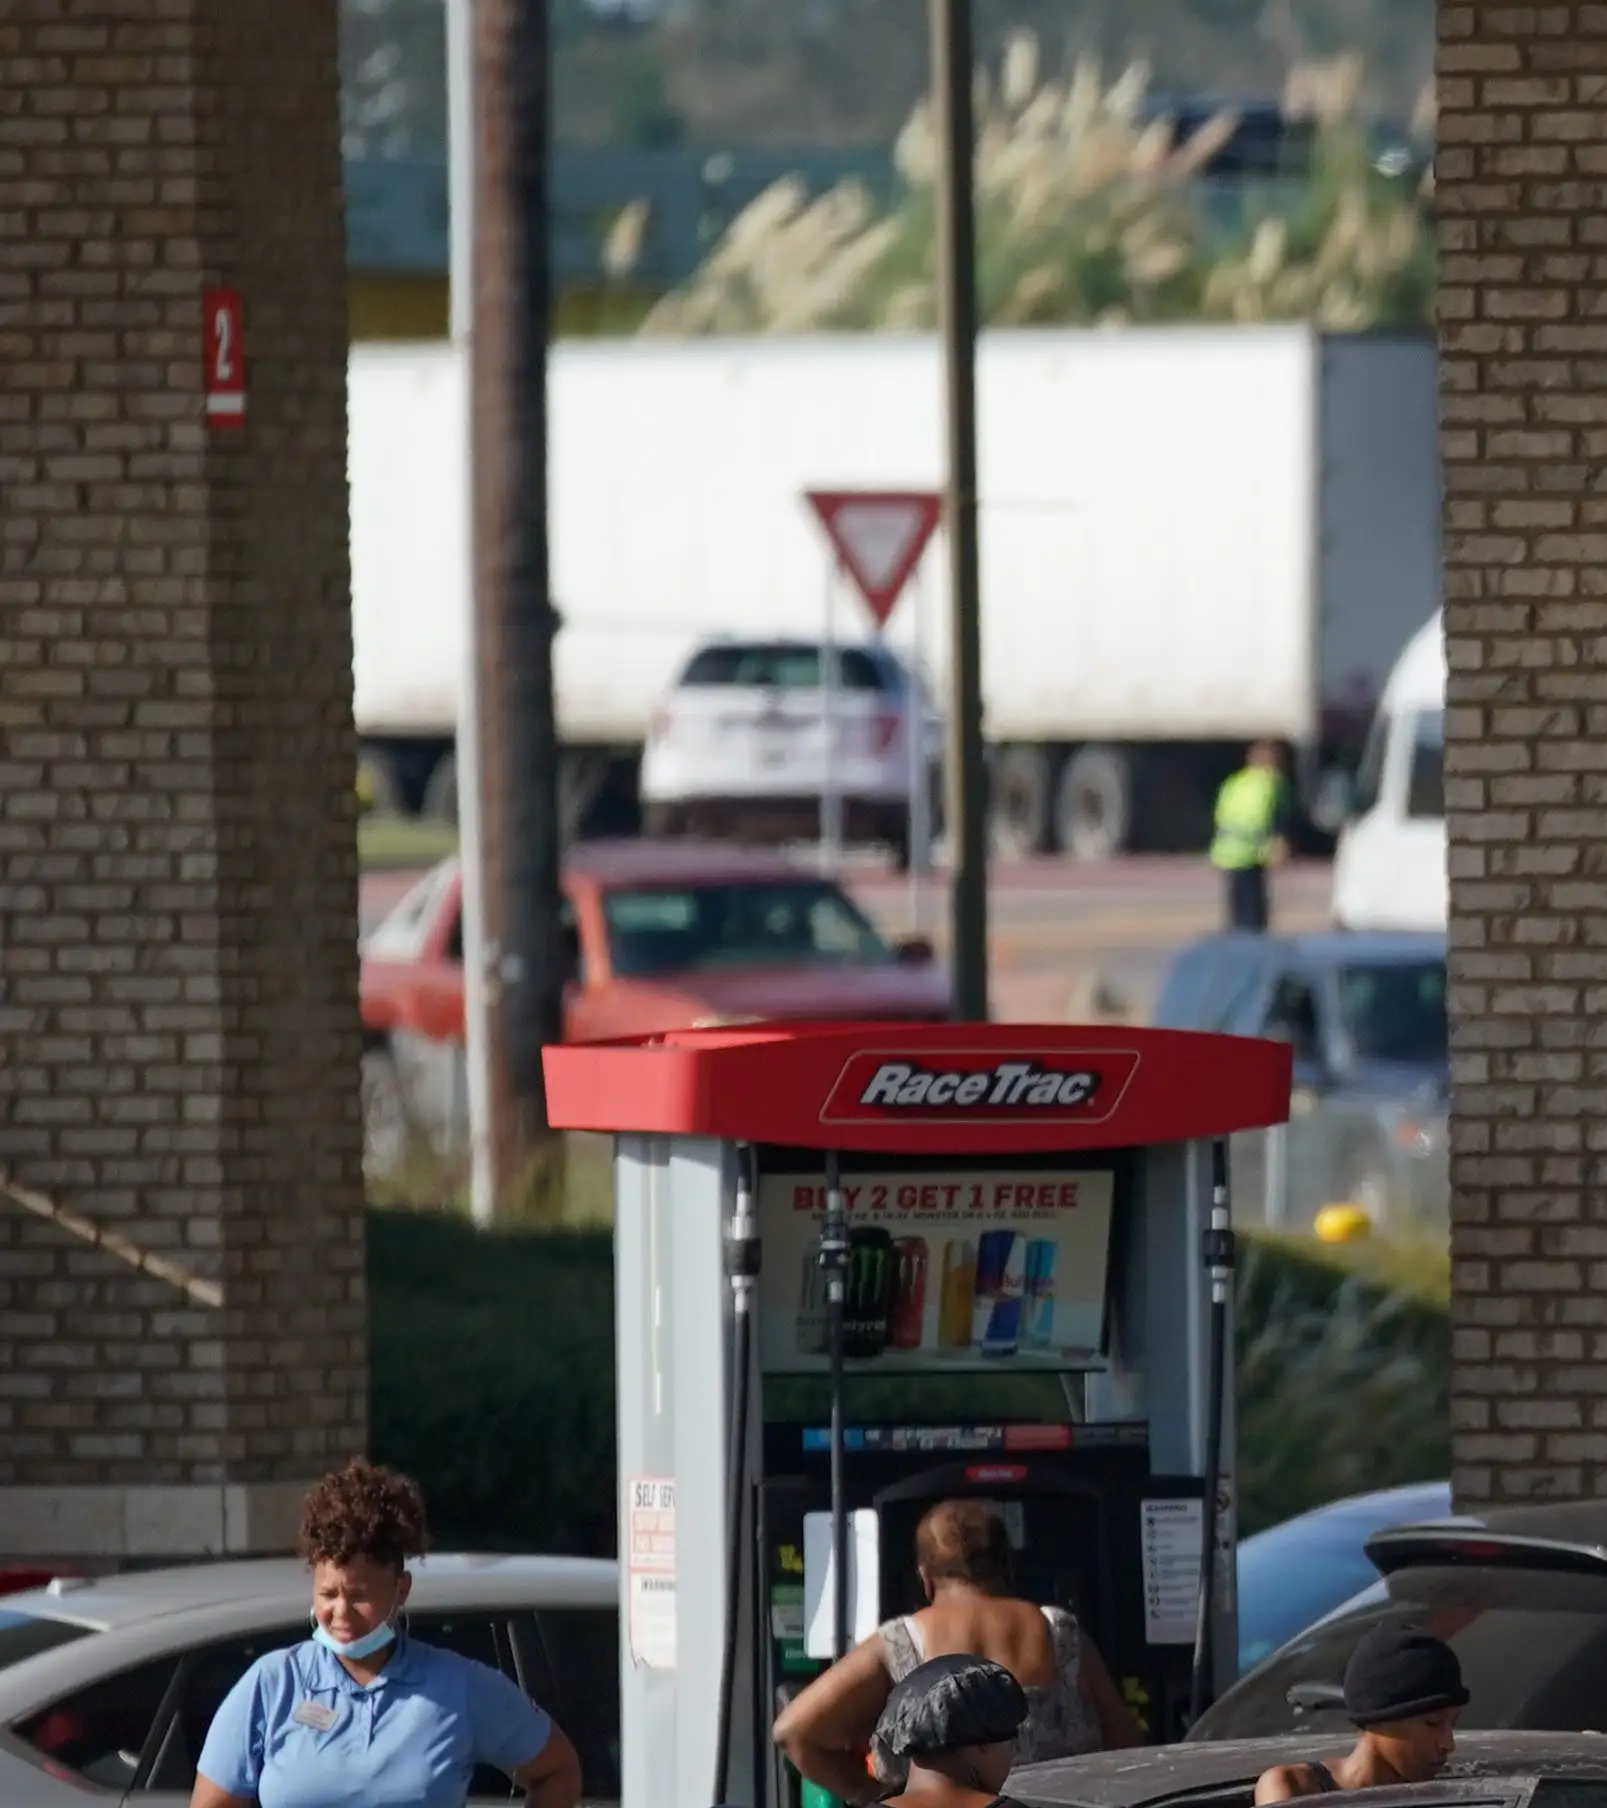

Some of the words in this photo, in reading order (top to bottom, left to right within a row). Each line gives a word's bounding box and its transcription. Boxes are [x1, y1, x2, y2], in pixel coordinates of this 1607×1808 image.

[213, 307, 233, 381] 2
[859, 1063, 1092, 1105] RaceTrac
[871, 1185, 890, 1210] 2
[896, 1184, 962, 1210] GET
[968, 1183, 984, 1208] 1
[994, 1181, 1080, 1209] FREE
